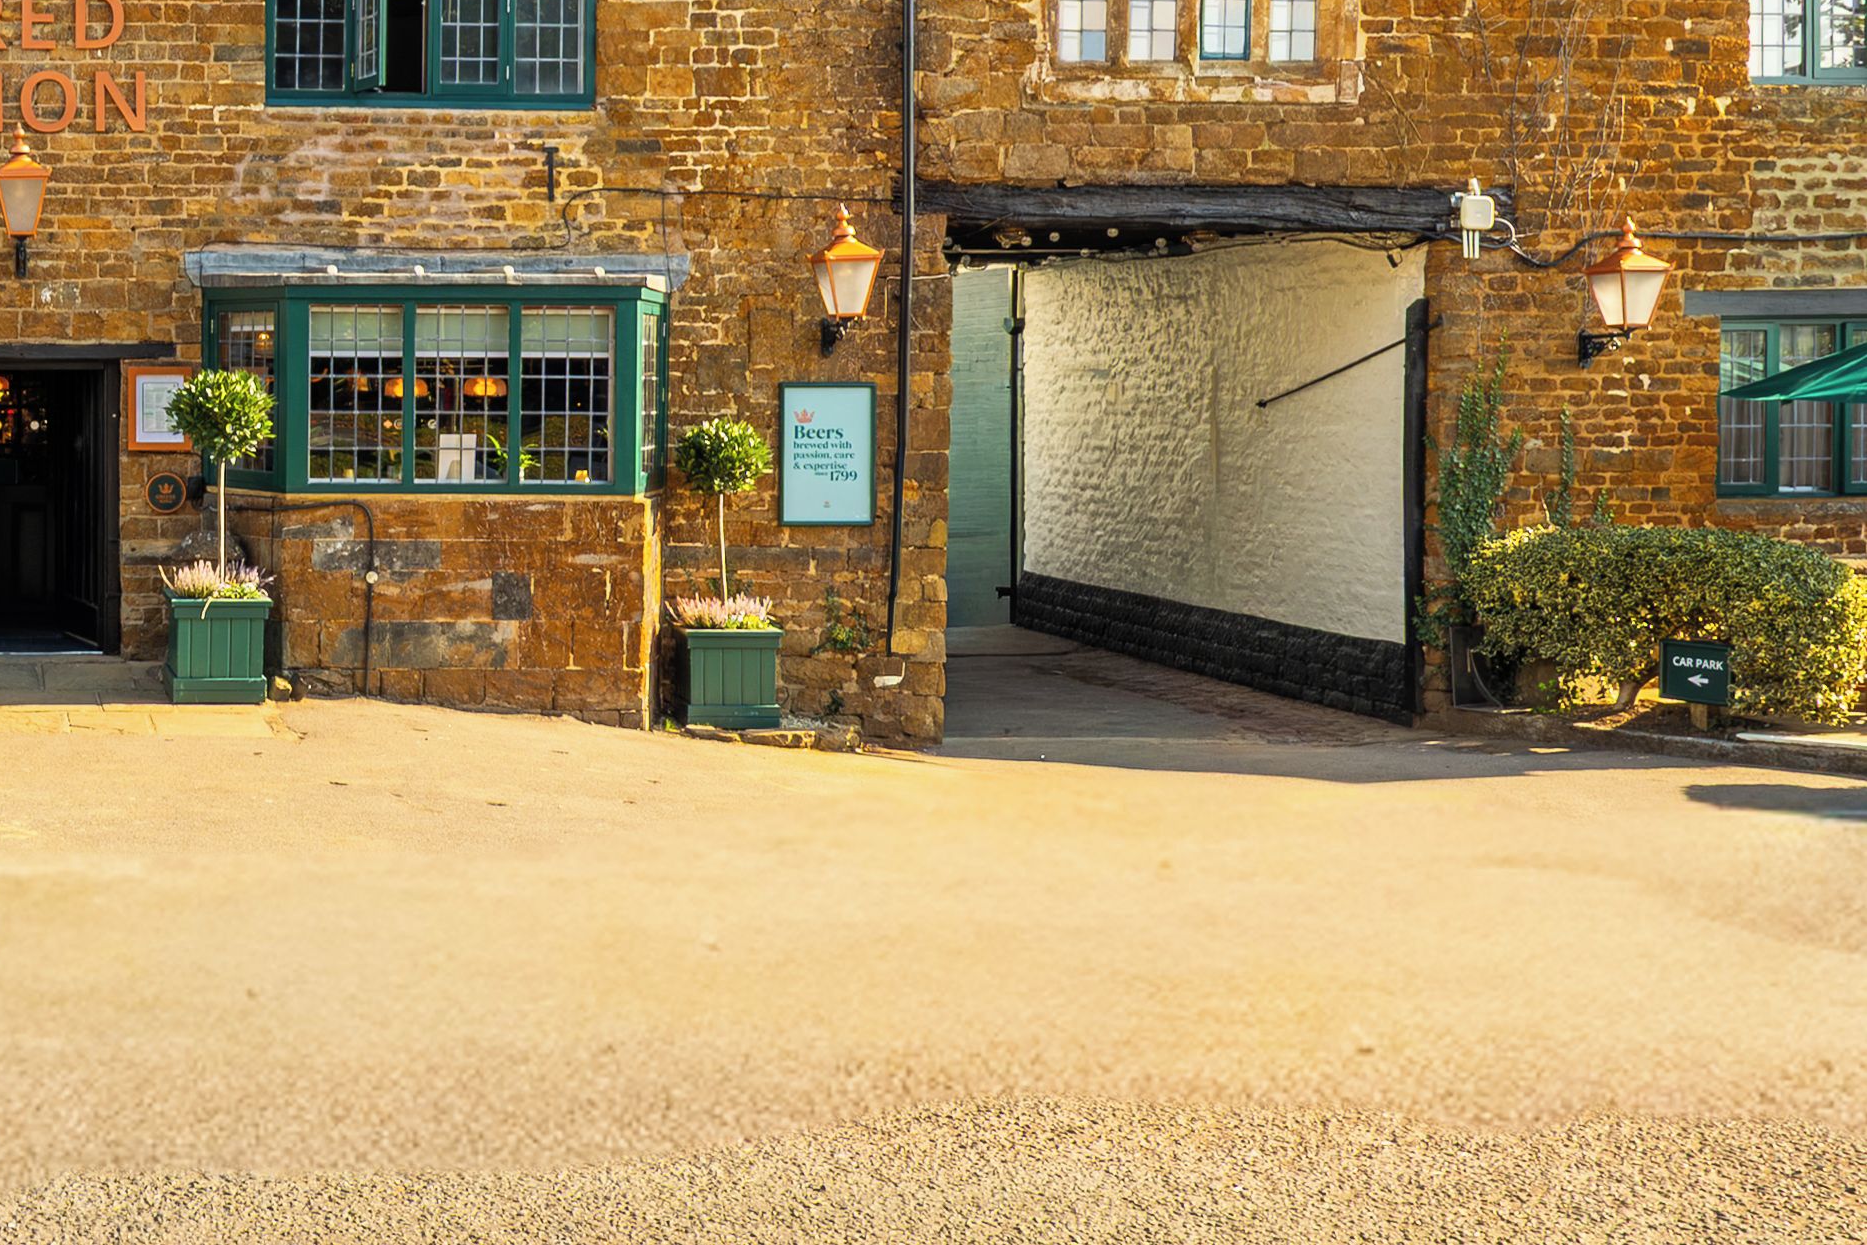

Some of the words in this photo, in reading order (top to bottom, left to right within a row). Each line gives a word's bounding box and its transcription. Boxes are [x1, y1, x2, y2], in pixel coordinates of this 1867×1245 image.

[794, 425, 844, 440] Beers
[793, 440, 829, 449] brewed
[830, 440, 852, 449] with
[793, 450, 832, 461] passion,
[793, 462, 801, 470] &
[803, 461, 848, 471] expertise
[830, 470, 858, 482] 1799
[1672, 656, 1694, 668] CAR
[1695, 658, 1724, 671] PARK
